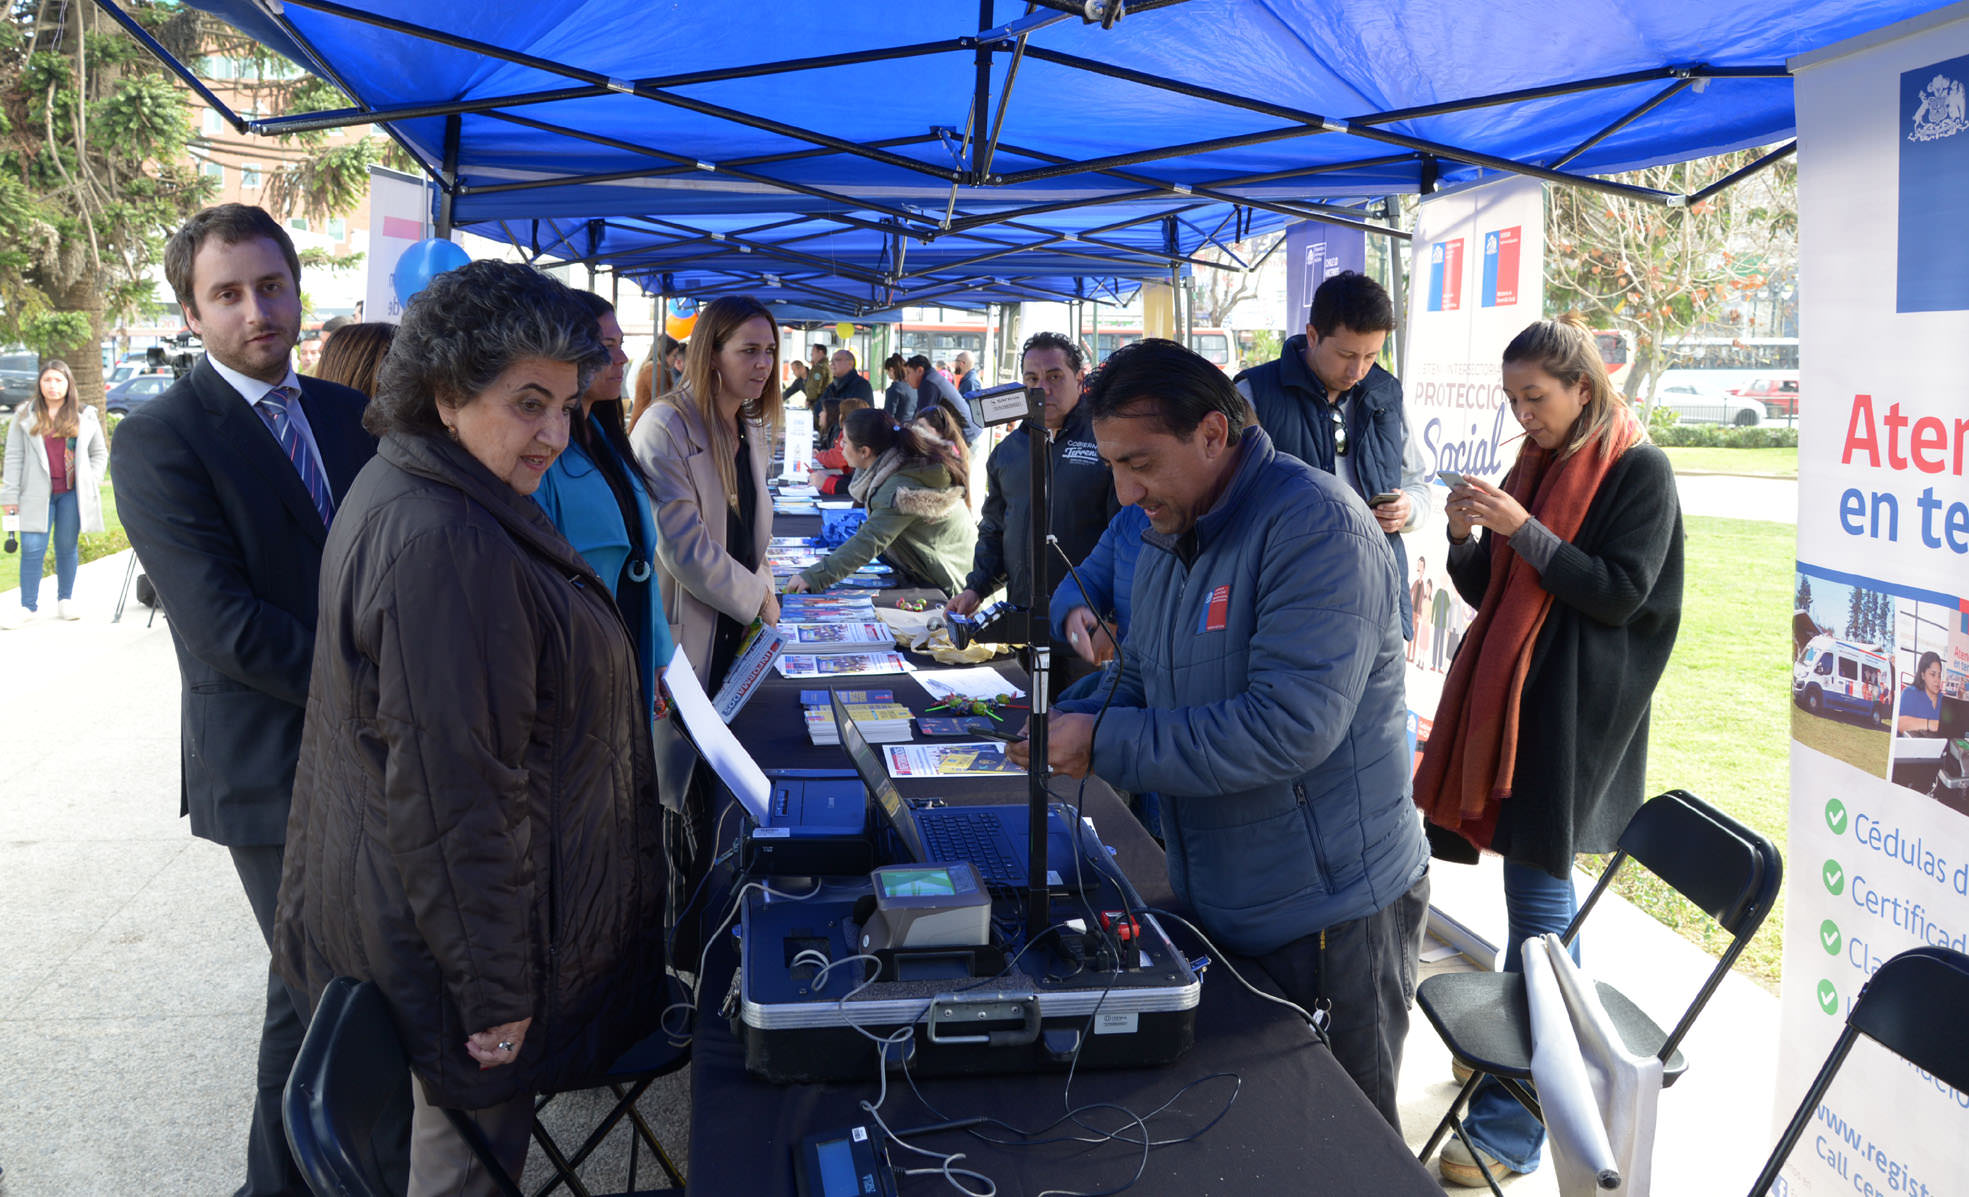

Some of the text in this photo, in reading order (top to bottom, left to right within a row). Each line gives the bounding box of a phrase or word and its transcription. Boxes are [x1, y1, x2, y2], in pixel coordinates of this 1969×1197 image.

[1414, 377, 1509, 410] PROTECCIÓ
[1423, 401, 1505, 483] Social
[1839, 487, 1899, 542] en
[1855, 813, 1947, 884] Cédulas
[1816, 1135, 1848, 1181] Call
